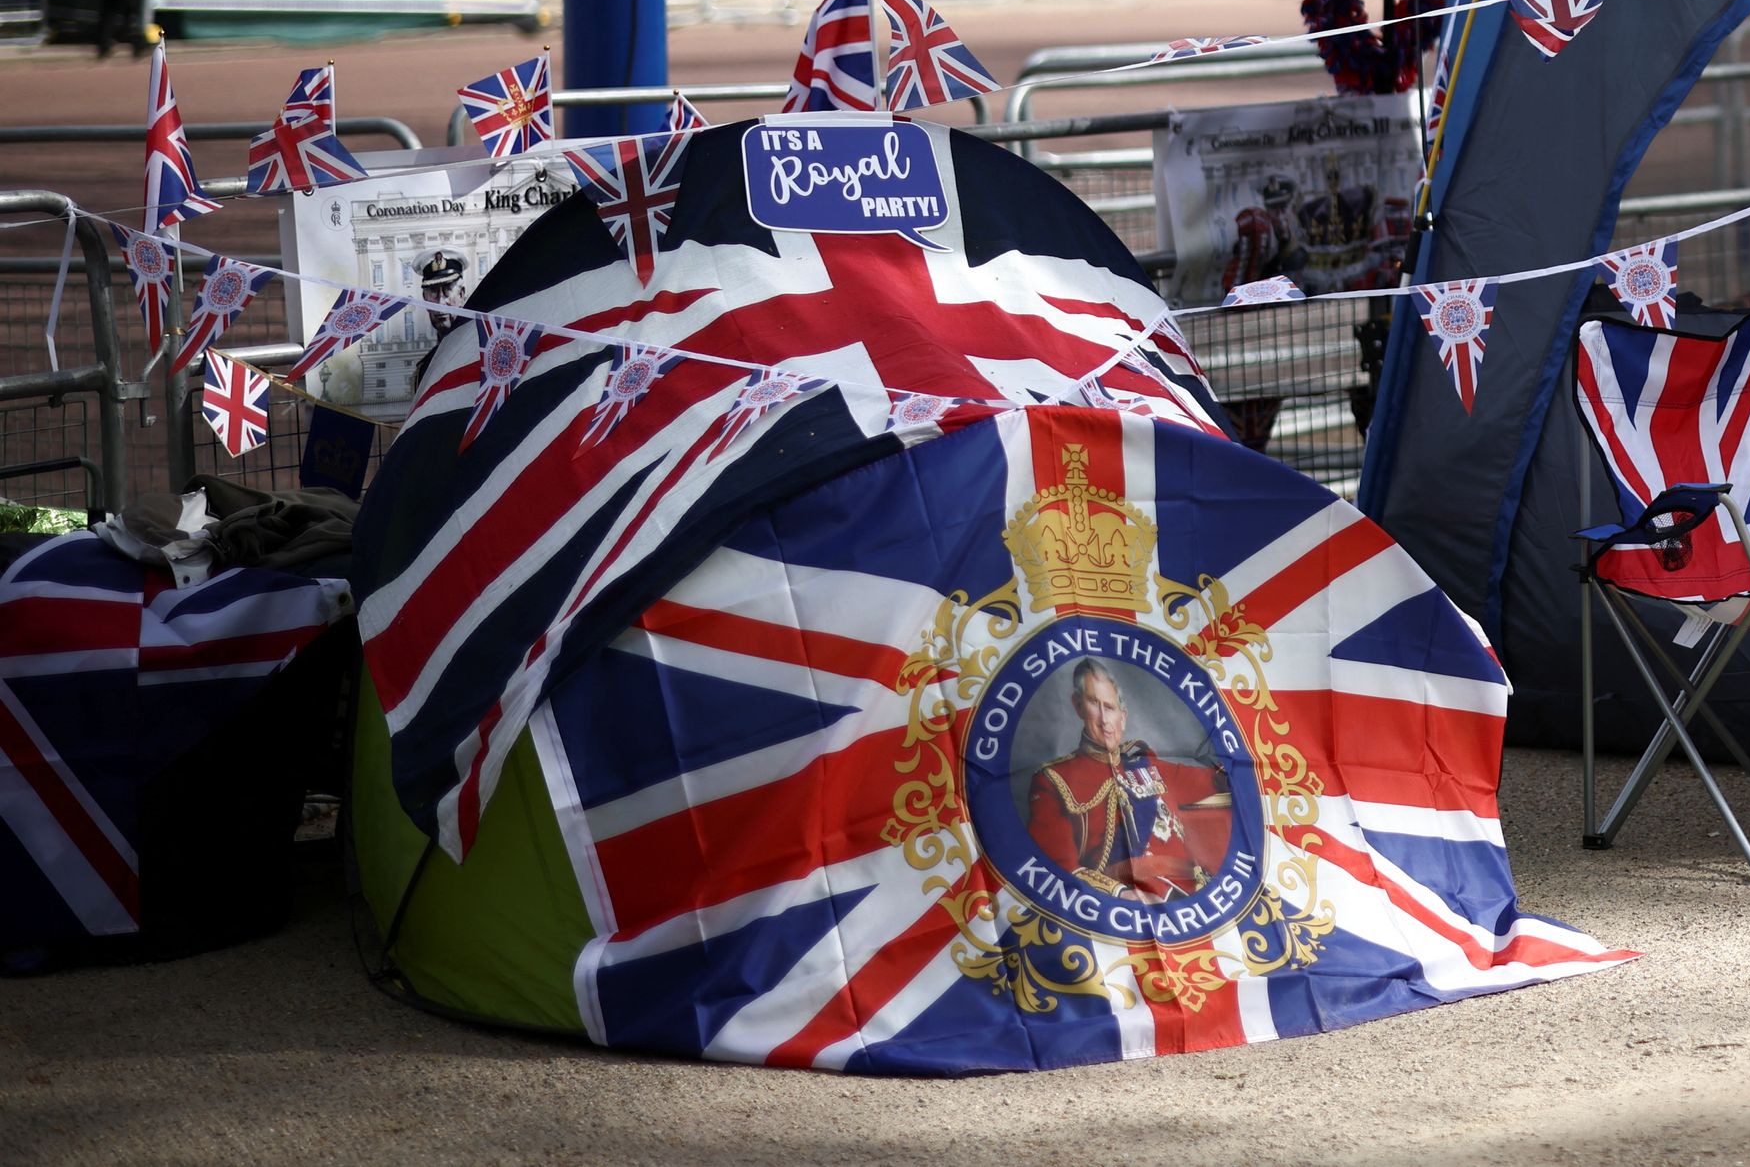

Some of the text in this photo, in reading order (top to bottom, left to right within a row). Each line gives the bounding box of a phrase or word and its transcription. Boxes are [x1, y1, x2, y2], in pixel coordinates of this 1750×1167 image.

[760, 130, 823, 151] IT'S A
[770, 131, 910, 205] Royal
[366, 200, 466, 218] Coronation Day
[484, 189, 521, 214] King
[861, 196, 940, 218] PARTY!
[976, 628, 1240, 760] GOD SAVE THE KING
[1016, 850, 1256, 937] KING CHARLES III
